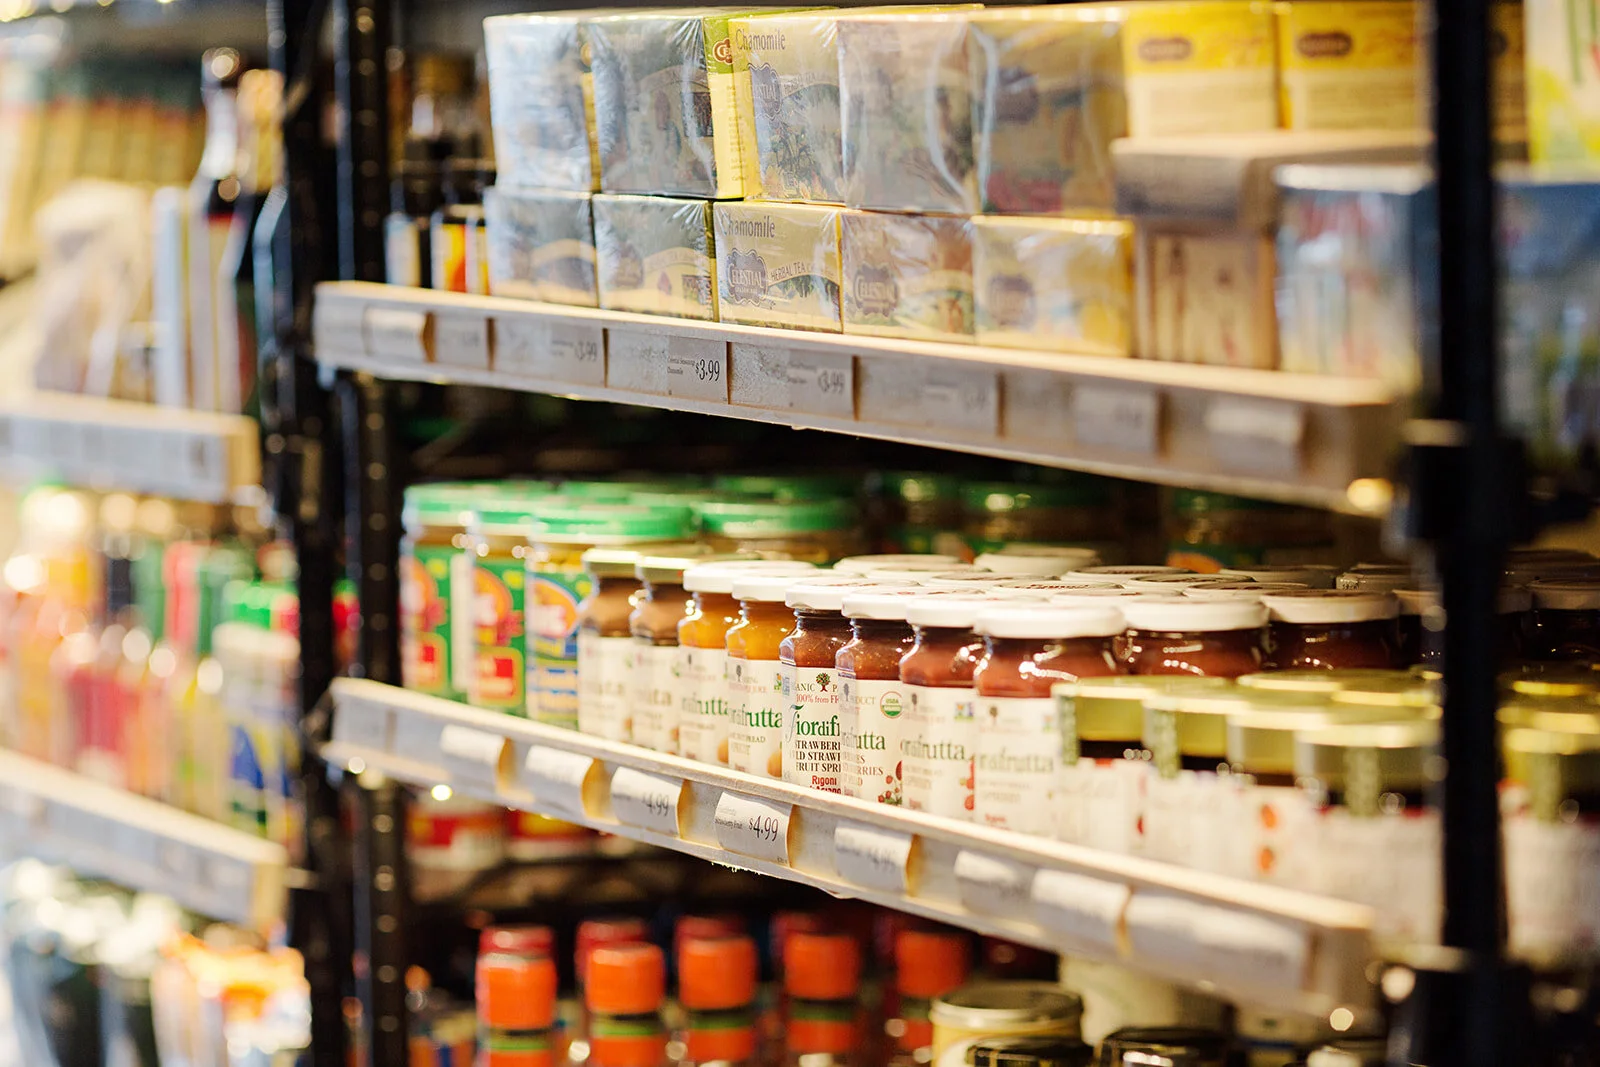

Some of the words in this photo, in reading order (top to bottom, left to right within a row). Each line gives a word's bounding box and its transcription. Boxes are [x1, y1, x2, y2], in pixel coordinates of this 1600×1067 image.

[735, 28, 786, 51] Chamomile
[721, 212, 776, 238] Chamomile
[727, 263, 765, 289] CELESTIAL
[770, 264, 793, 281] HERBAL
[793, 261, 806, 275] TEA
[695, 358, 720, 382] $3.99
[796, 693, 814, 704] 100%
[814, 695, 830, 704] from
[811, 775, 837, 786] Rigoni
[748, 815, 779, 842] $4.99
